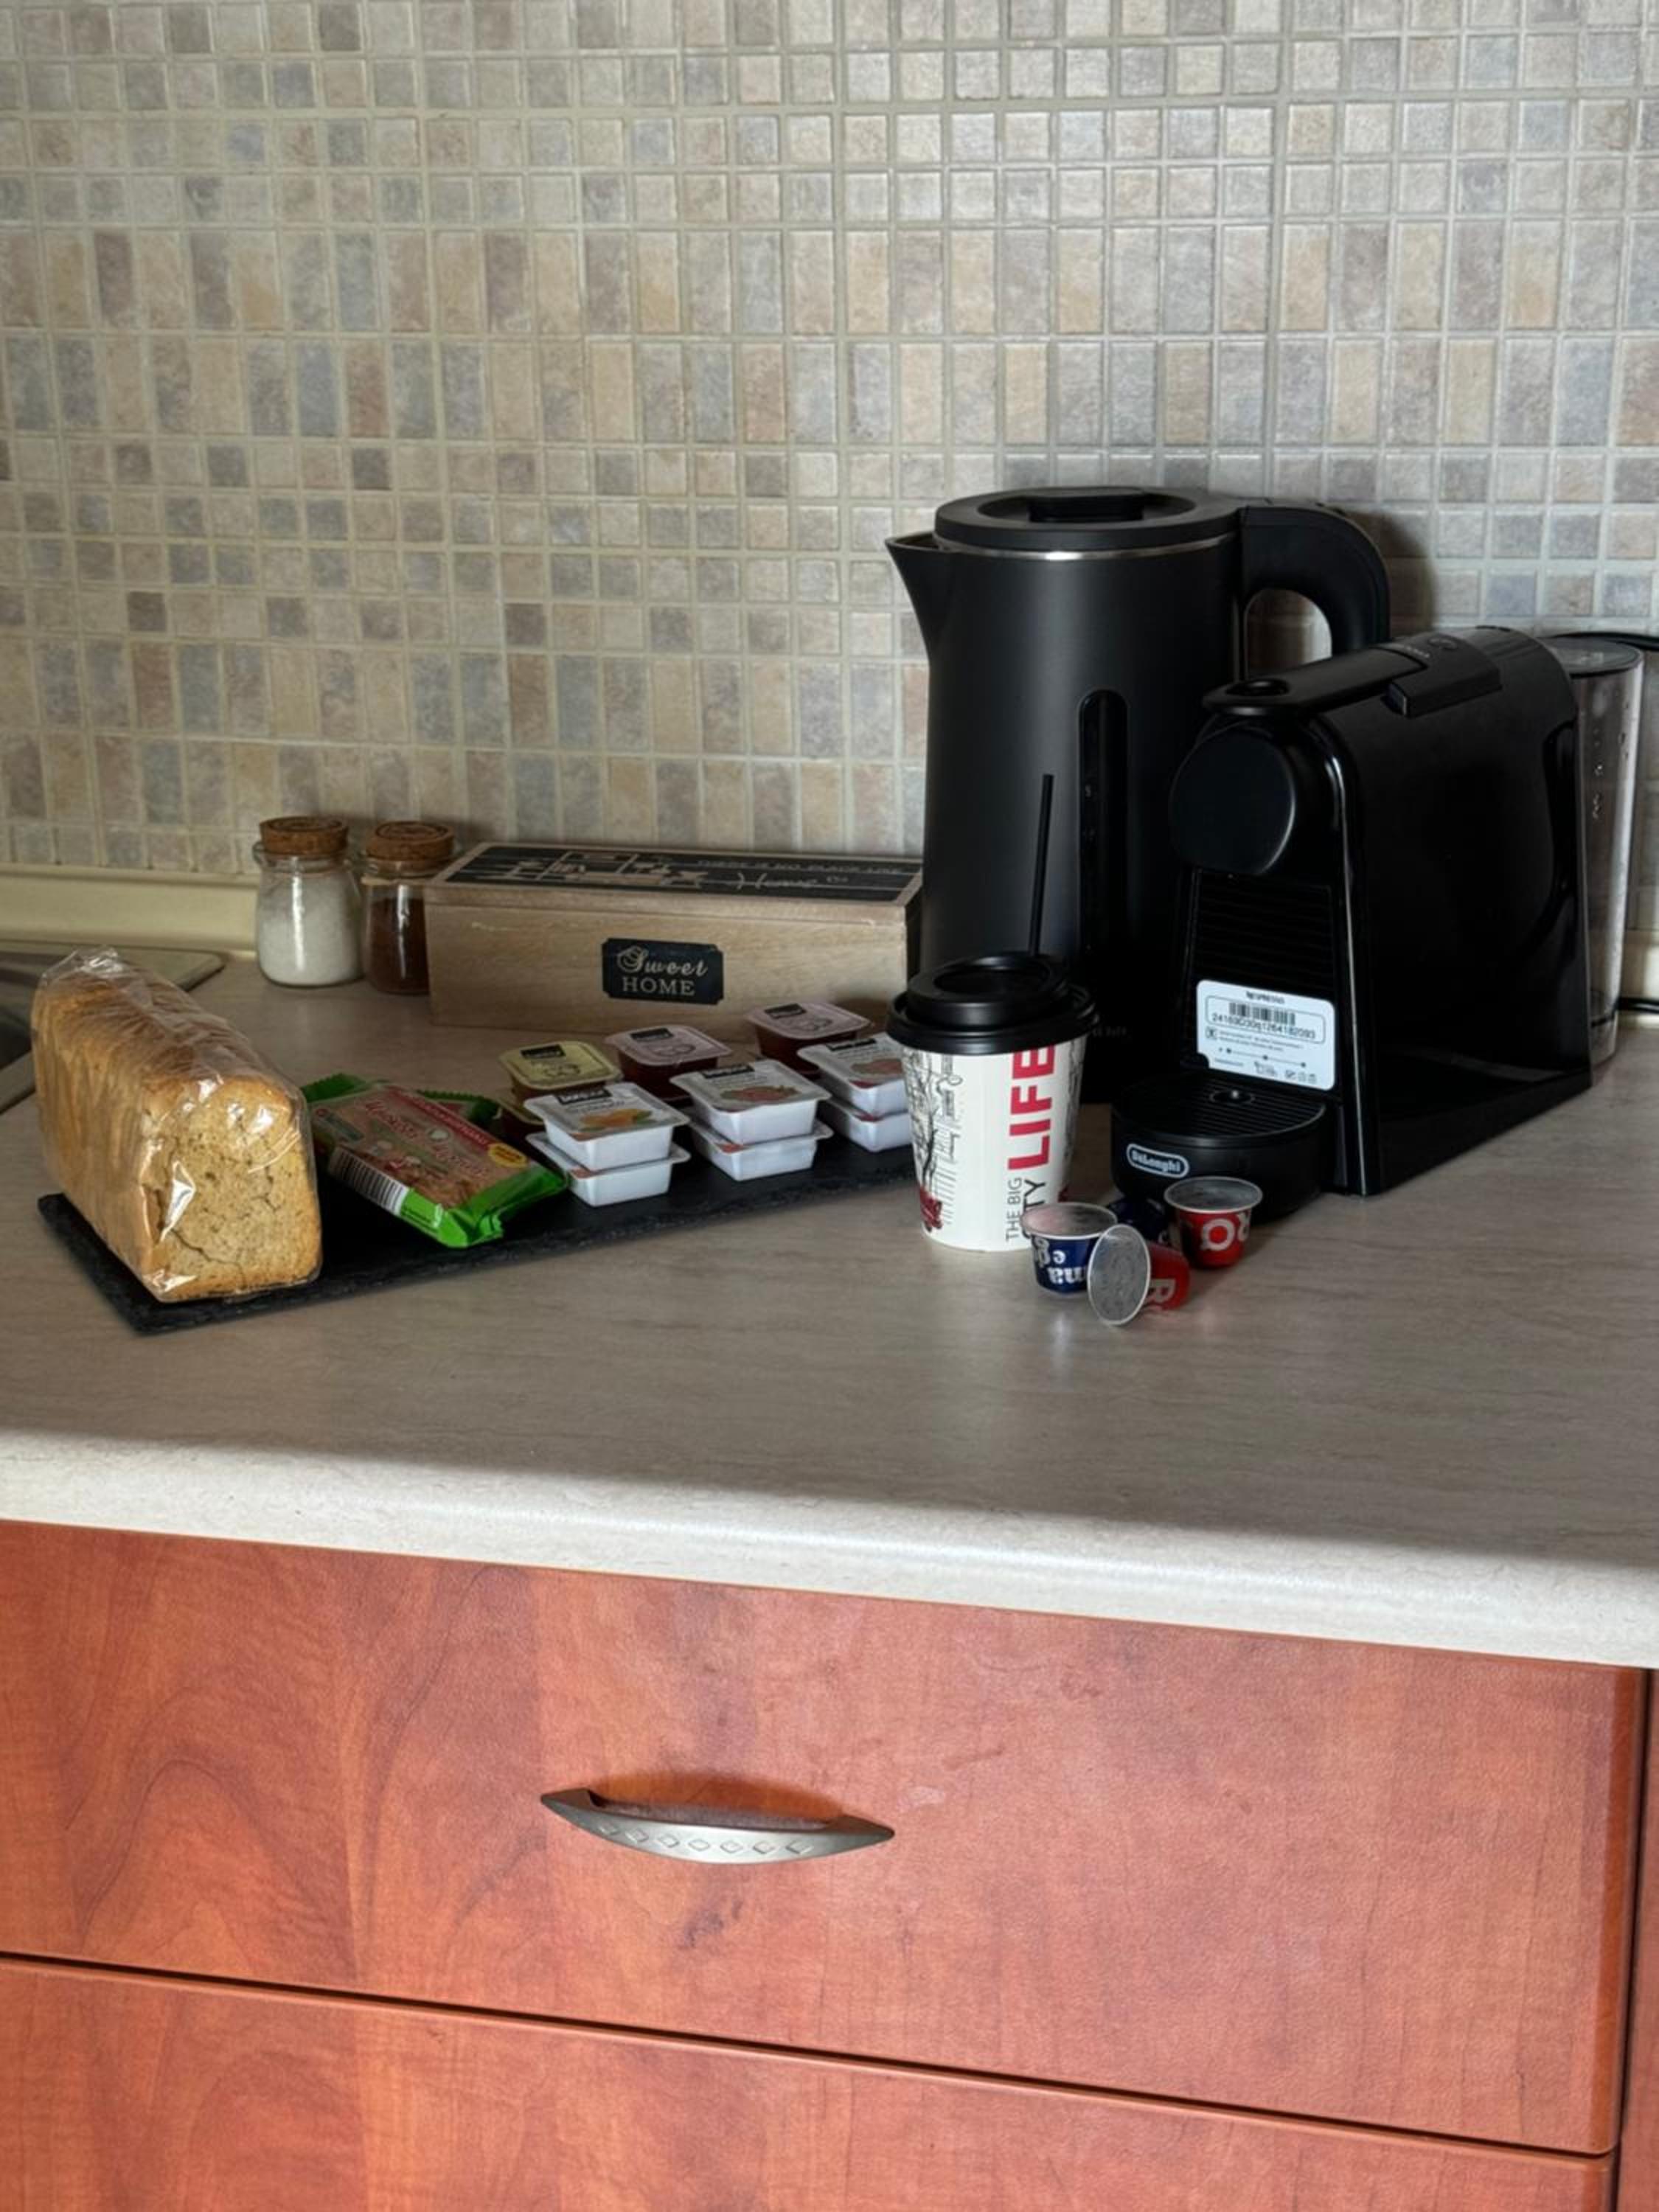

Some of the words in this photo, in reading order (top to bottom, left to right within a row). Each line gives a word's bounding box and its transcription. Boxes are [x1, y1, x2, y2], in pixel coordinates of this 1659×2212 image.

[616, 945, 708, 976] Sweet
[622, 976, 695, 995] HOME
[1007, 1045, 1055, 1171] LIFE
[1007, 1177, 1023, 1206] BIG
[1006, 1209, 1020, 1242] THE
